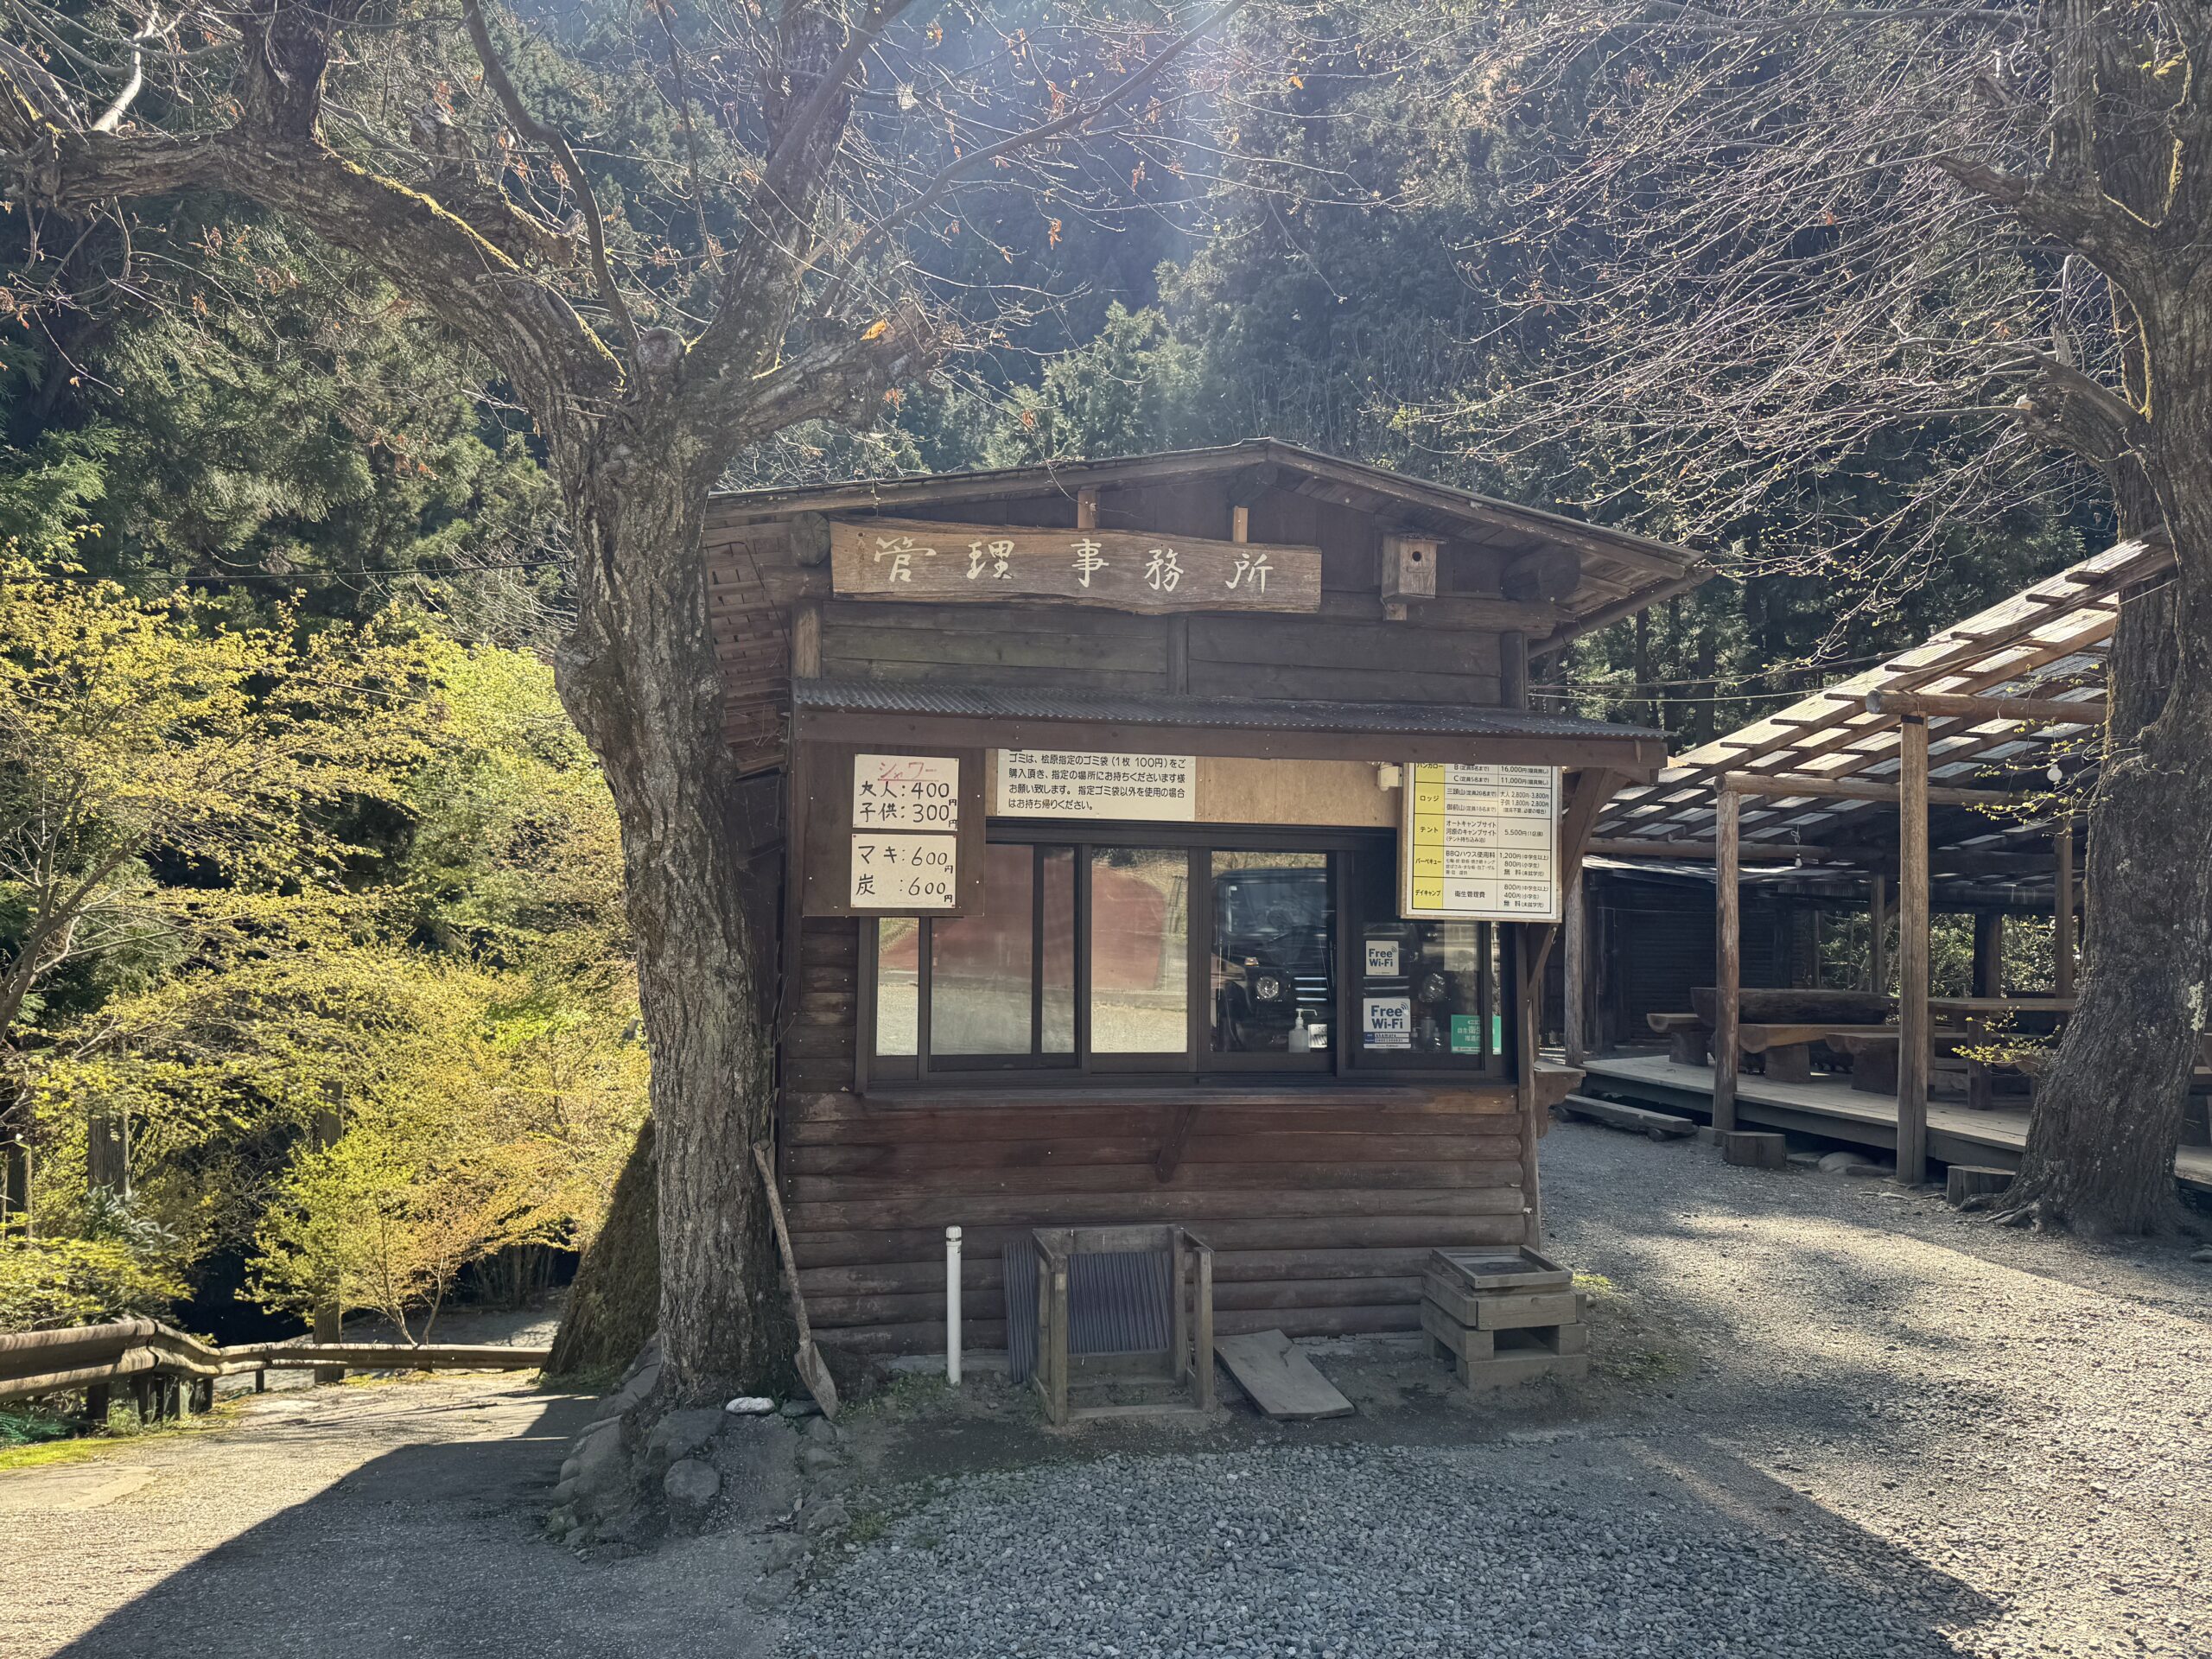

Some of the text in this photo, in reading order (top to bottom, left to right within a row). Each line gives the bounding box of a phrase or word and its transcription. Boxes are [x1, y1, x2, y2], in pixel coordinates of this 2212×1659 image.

[874, 537, 1273, 593] 管理事務所
[879, 761, 937, 779] シャワー
[1008, 798, 1093, 810] はお持ち帰りください。
[1369, 948, 1393, 957] Free
[1369, 958, 1393, 967] Wi-Fi
[1370, 1005, 1403, 1017] Free
[1371, 1018, 1403, 1029] Wi-Fi
